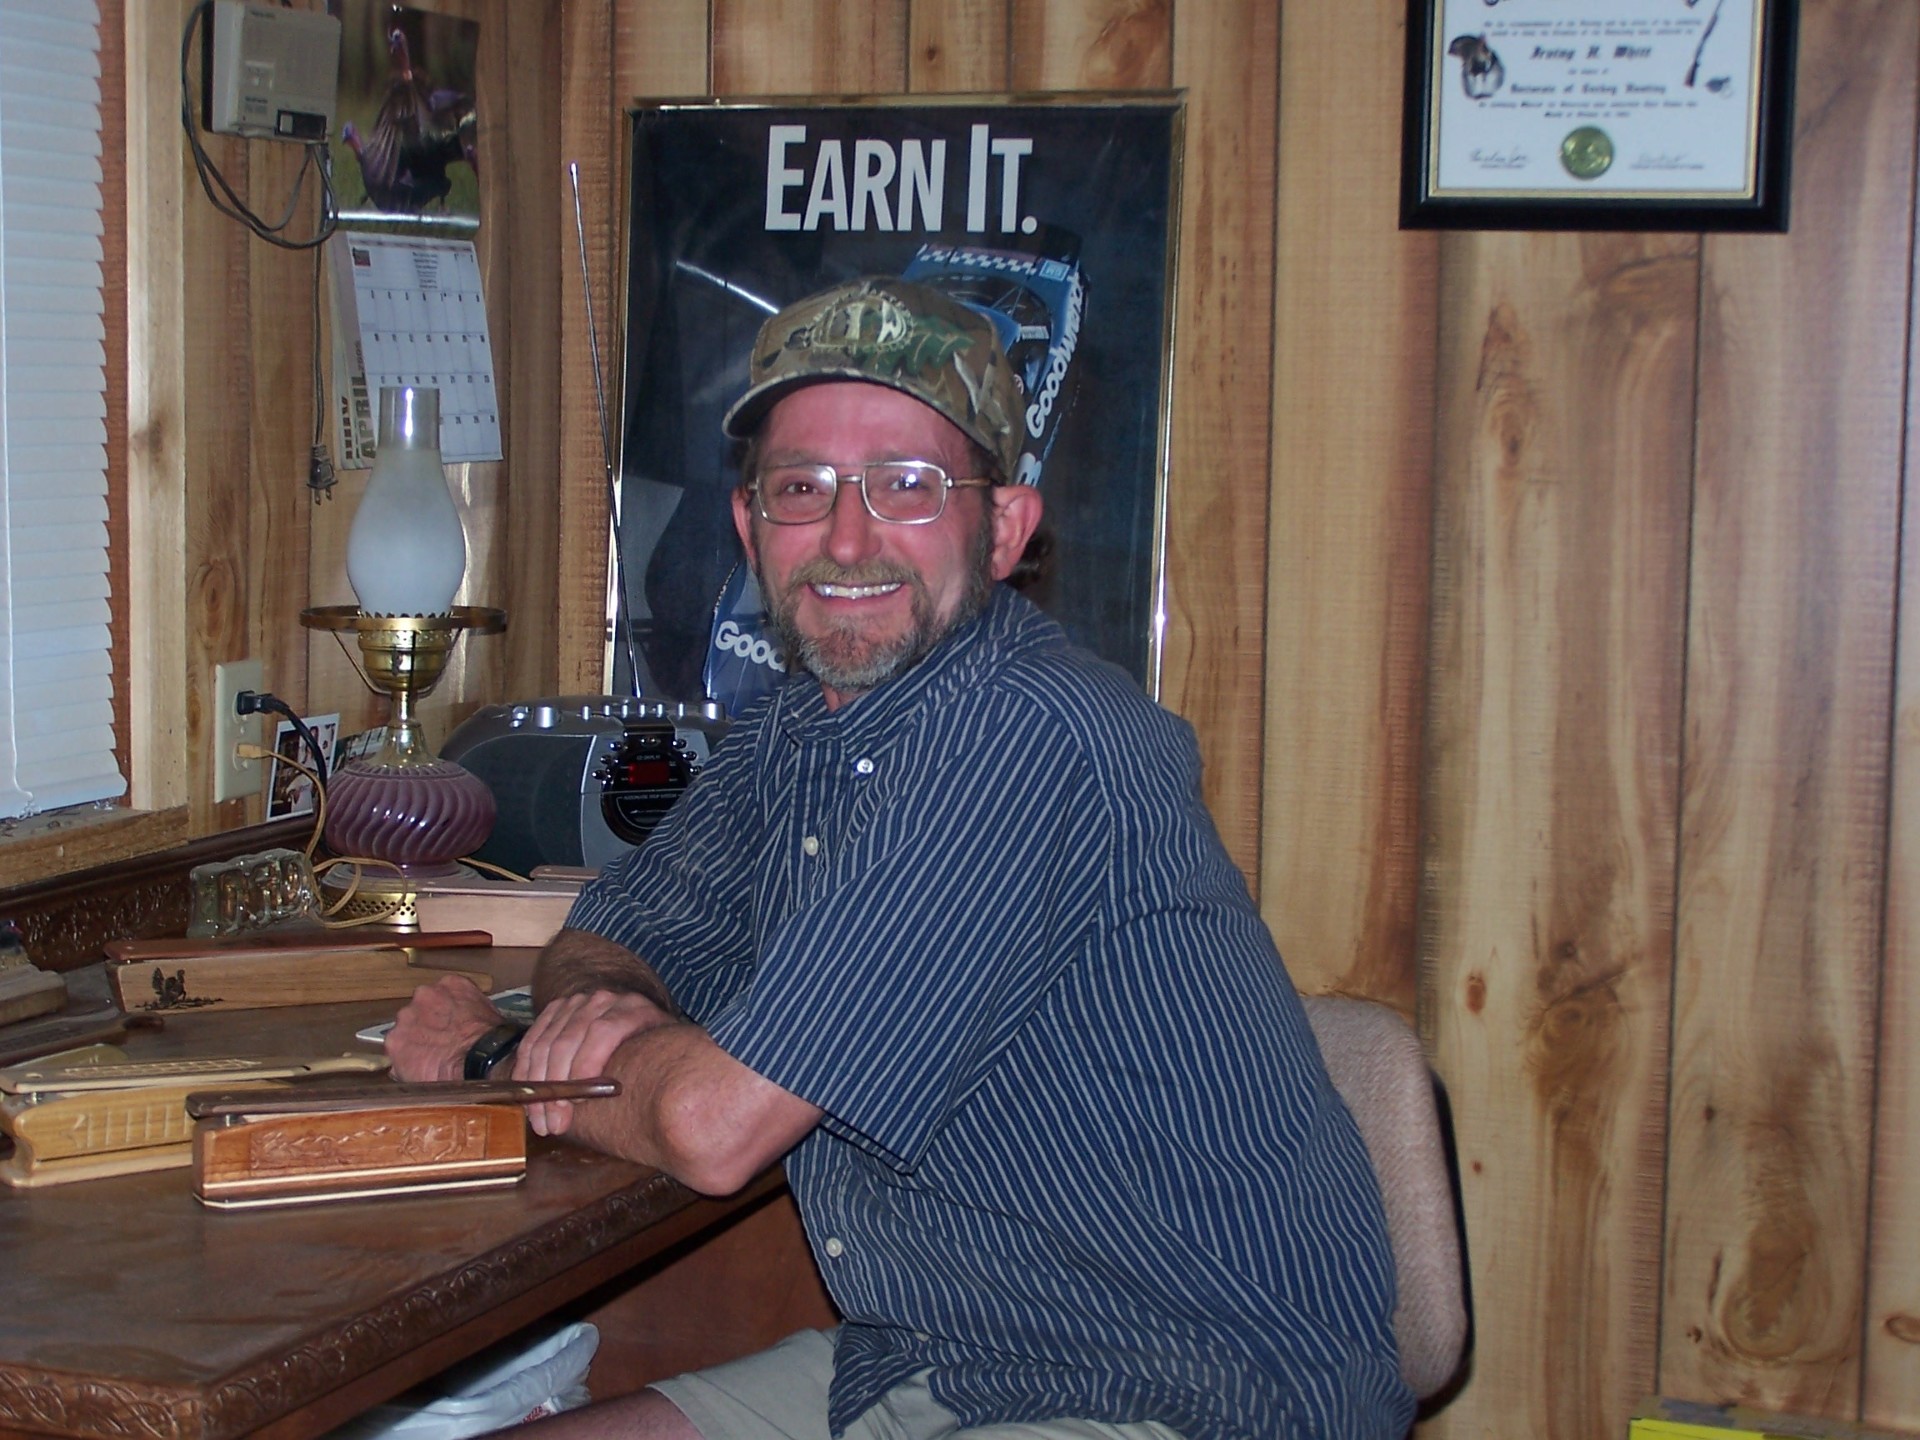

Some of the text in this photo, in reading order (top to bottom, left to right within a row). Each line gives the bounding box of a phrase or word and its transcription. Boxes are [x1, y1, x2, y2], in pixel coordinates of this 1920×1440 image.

[764, 124, 1037, 234] EARN IT.
[351, 372, 377, 459] APRIL
